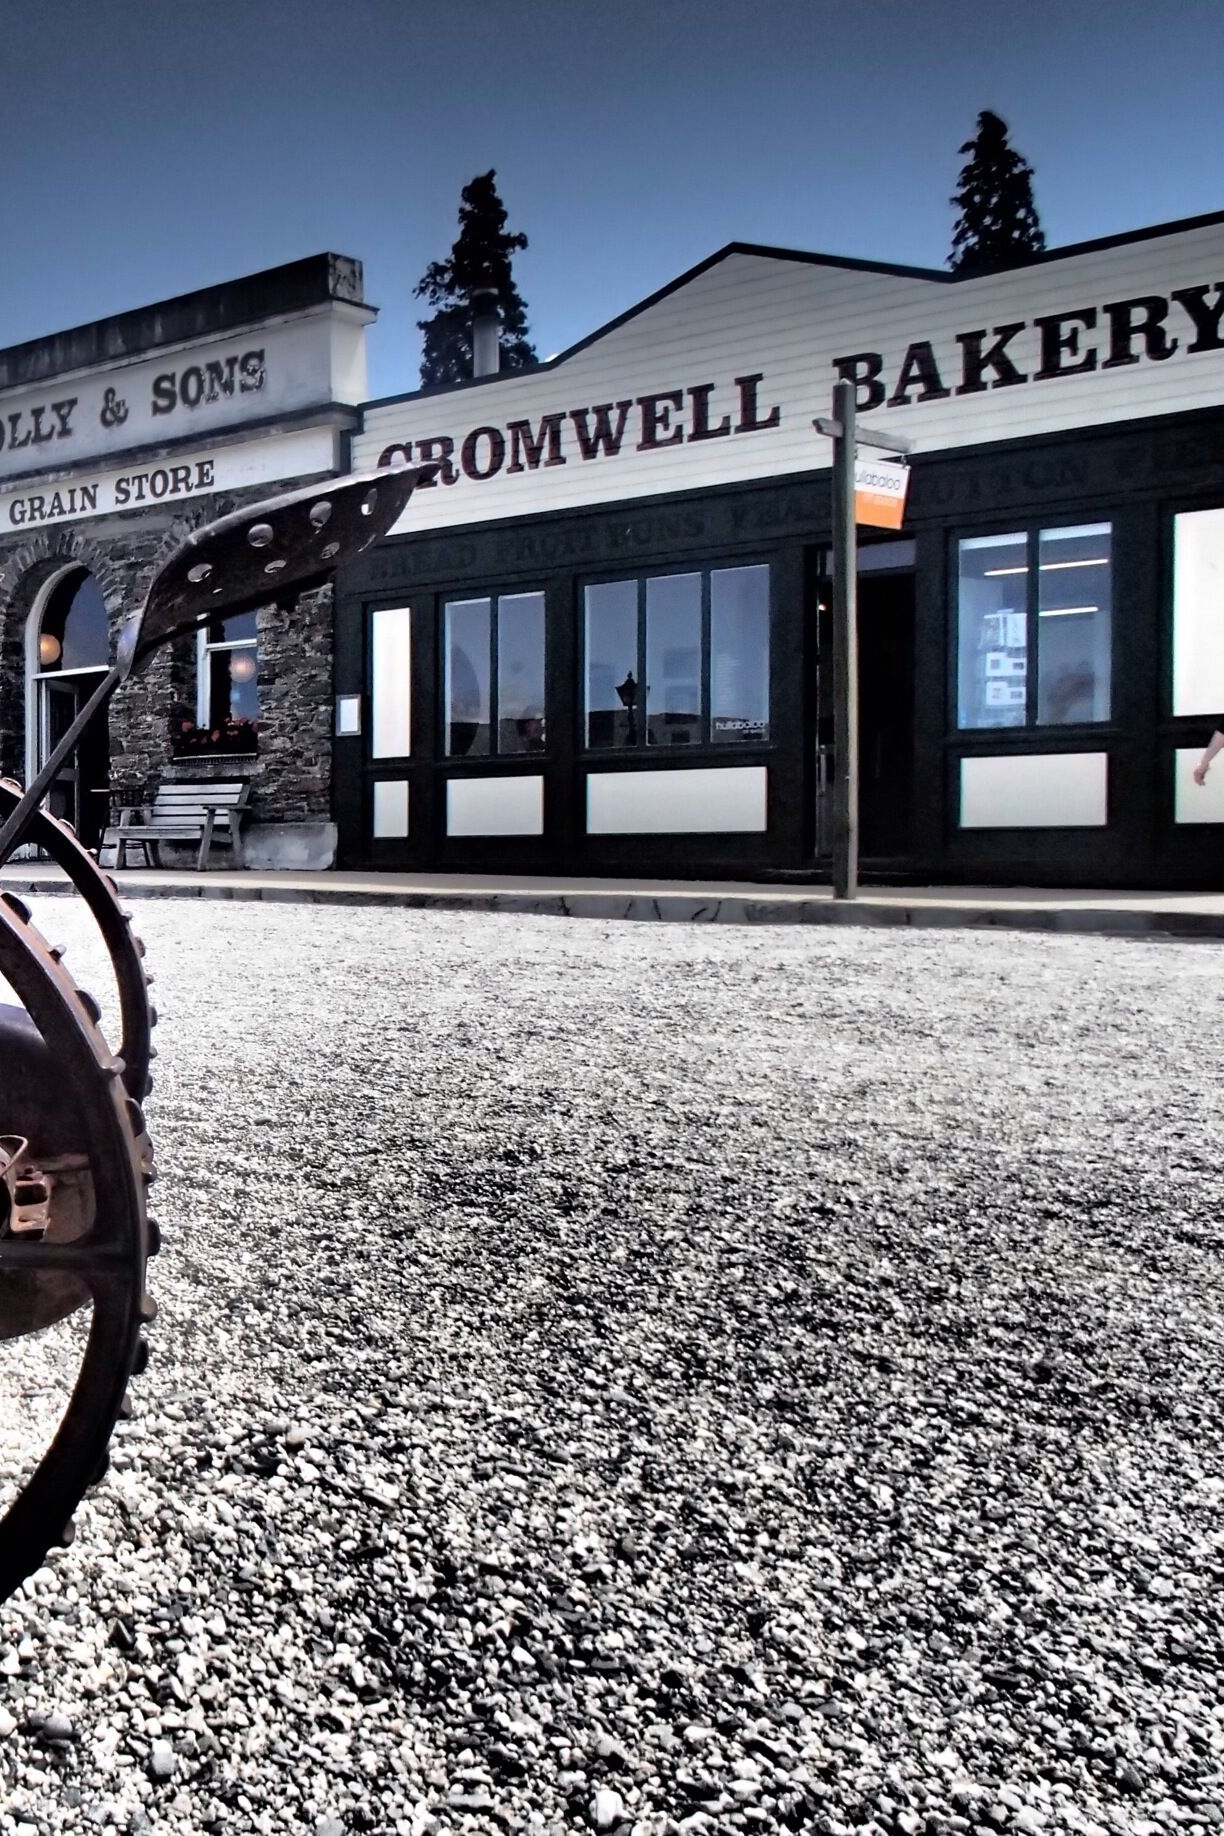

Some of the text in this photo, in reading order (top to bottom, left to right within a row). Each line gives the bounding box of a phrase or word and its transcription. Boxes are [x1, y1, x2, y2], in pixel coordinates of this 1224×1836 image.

[833, 282, 1224, 413] BAKERY
[100, 387, 129, 428] &
[152, 349, 266, 416] SONS
[10, 484, 99, 525] GRAIN
[115, 460, 214, 506] STORE
